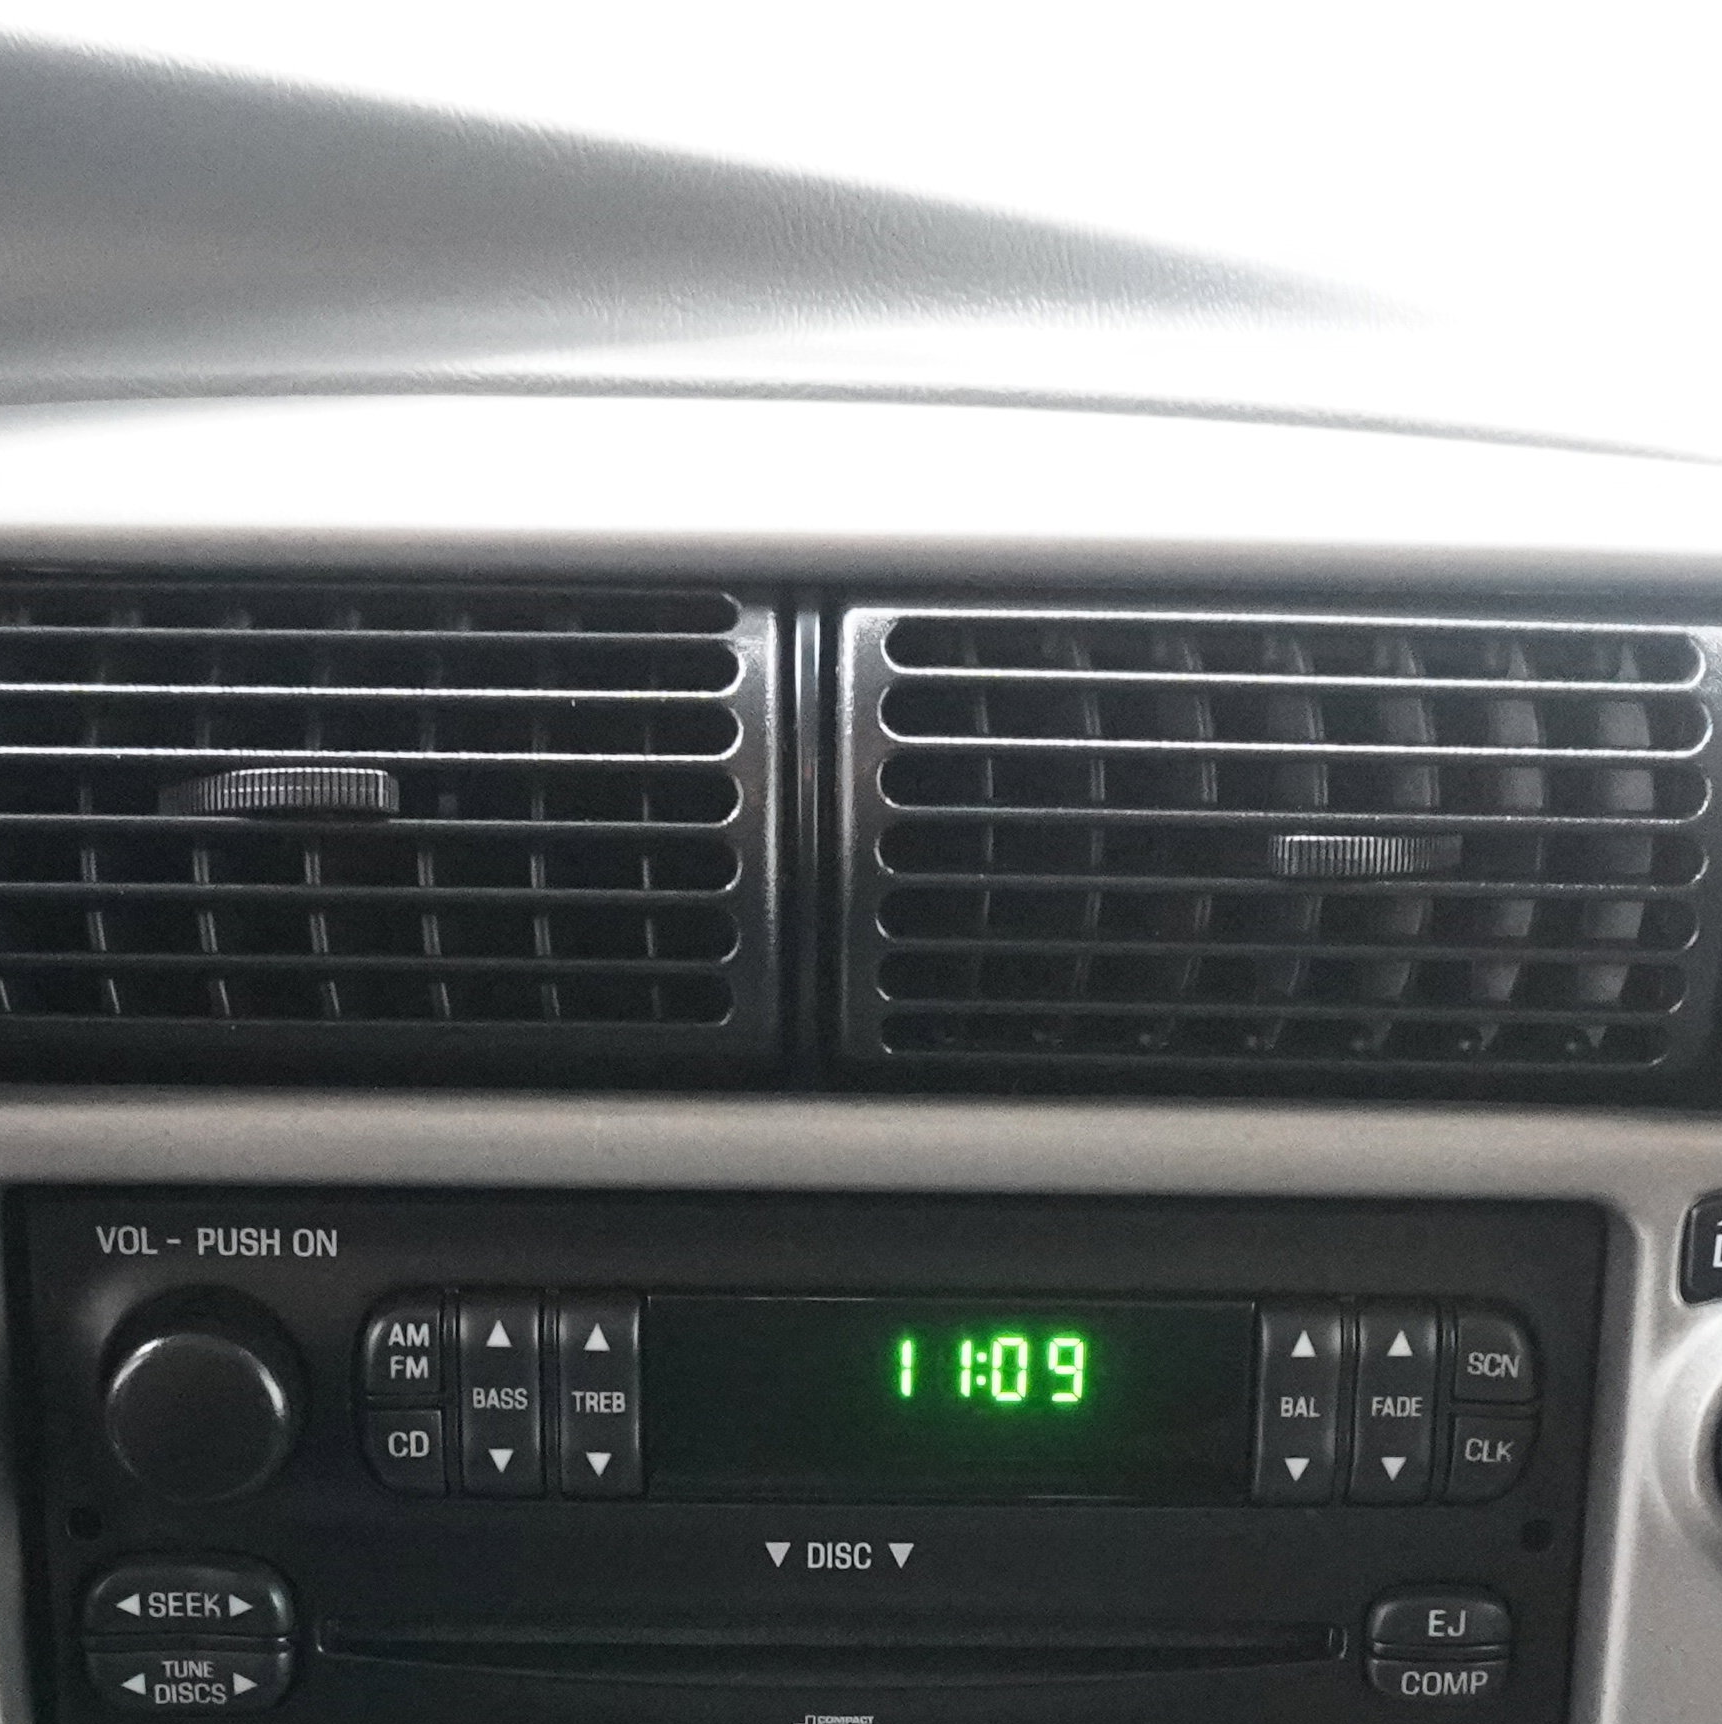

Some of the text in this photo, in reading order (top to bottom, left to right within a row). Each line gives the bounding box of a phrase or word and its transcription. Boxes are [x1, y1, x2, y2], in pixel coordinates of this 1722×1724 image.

[96, 1226, 159, 1255] VOL
[196, 1227, 282, 1257] PUSH
[292, 1228, 339, 1258] ON
[387, 1323, 430, 1348] AM
[389, 1355, 430, 1380] FM
[897, 1335, 1087, 1403] 11:09
[1466, 1352, 1521, 1381] SCN
[472, 1387, 529, 1411] BASS
[571, 1390, 626, 1414] TREB
[1279, 1396, 1321, 1420] BAL
[1371, 1396, 1424, 1419] FADE
[387, 1431, 430, 1459] CD
[1464, 1438, 1514, 1464] CLK
[806, 1542, 873, 1571] DISC
[147, 1592, 222, 1618] SEEK
[1427, 1609, 1467, 1638] EJ
[161, 1659, 215, 1679] TUNE
[153, 1679, 227, 1705] DISCS
[1400, 1670, 1489, 1697] COMP
[818, 1715, 875, 1724] COMPACT
